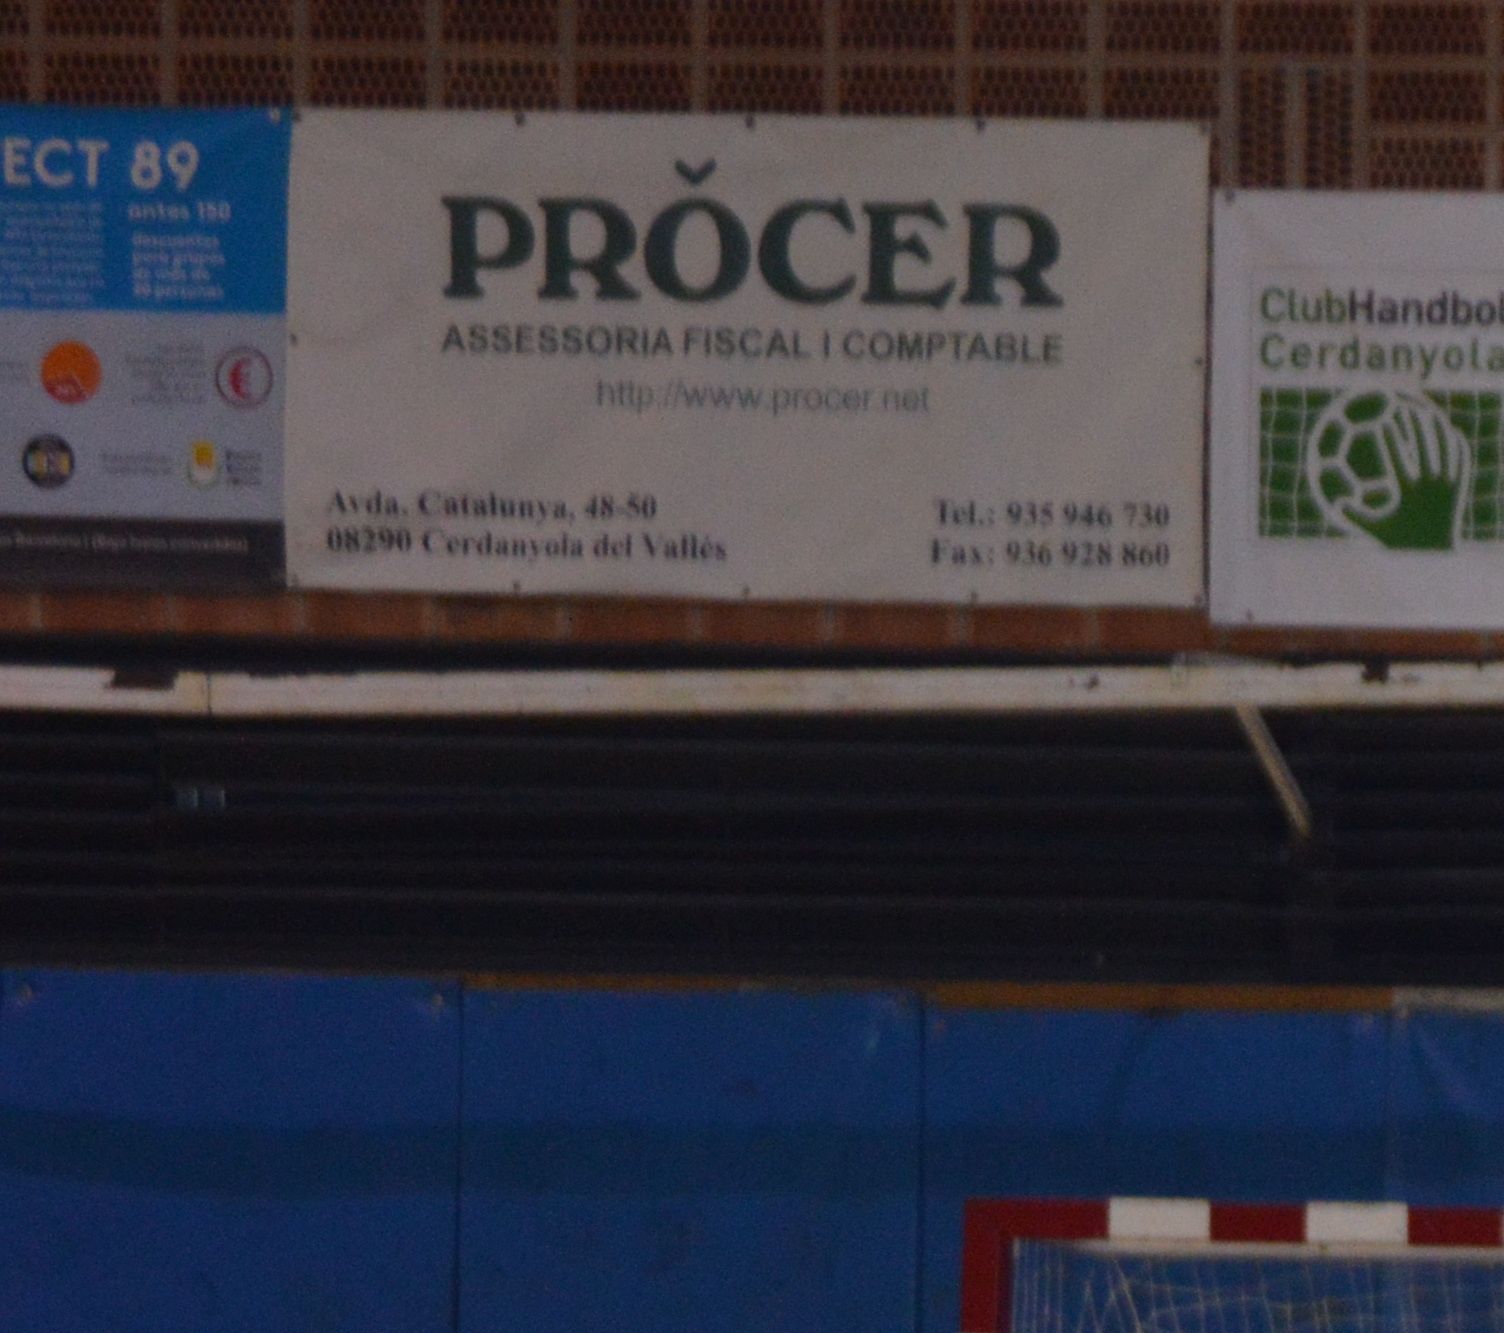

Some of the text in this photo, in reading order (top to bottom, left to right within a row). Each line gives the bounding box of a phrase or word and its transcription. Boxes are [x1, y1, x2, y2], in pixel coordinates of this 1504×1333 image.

[130, 140, 200, 191] 89
[127, 203, 190, 222] antes
[441, 324, 673, 356] ASSESSORIA
[683, 326, 802, 360] FISCAL
[843, 329, 1064, 364] COMPTABLE
[327, 490, 659, 527] Avda. Catalunya, 48-50
[326, 524, 413, 554] 08290
[420, 527, 584, 564] Cerdanyola
[592, 531, 634, 560] del
